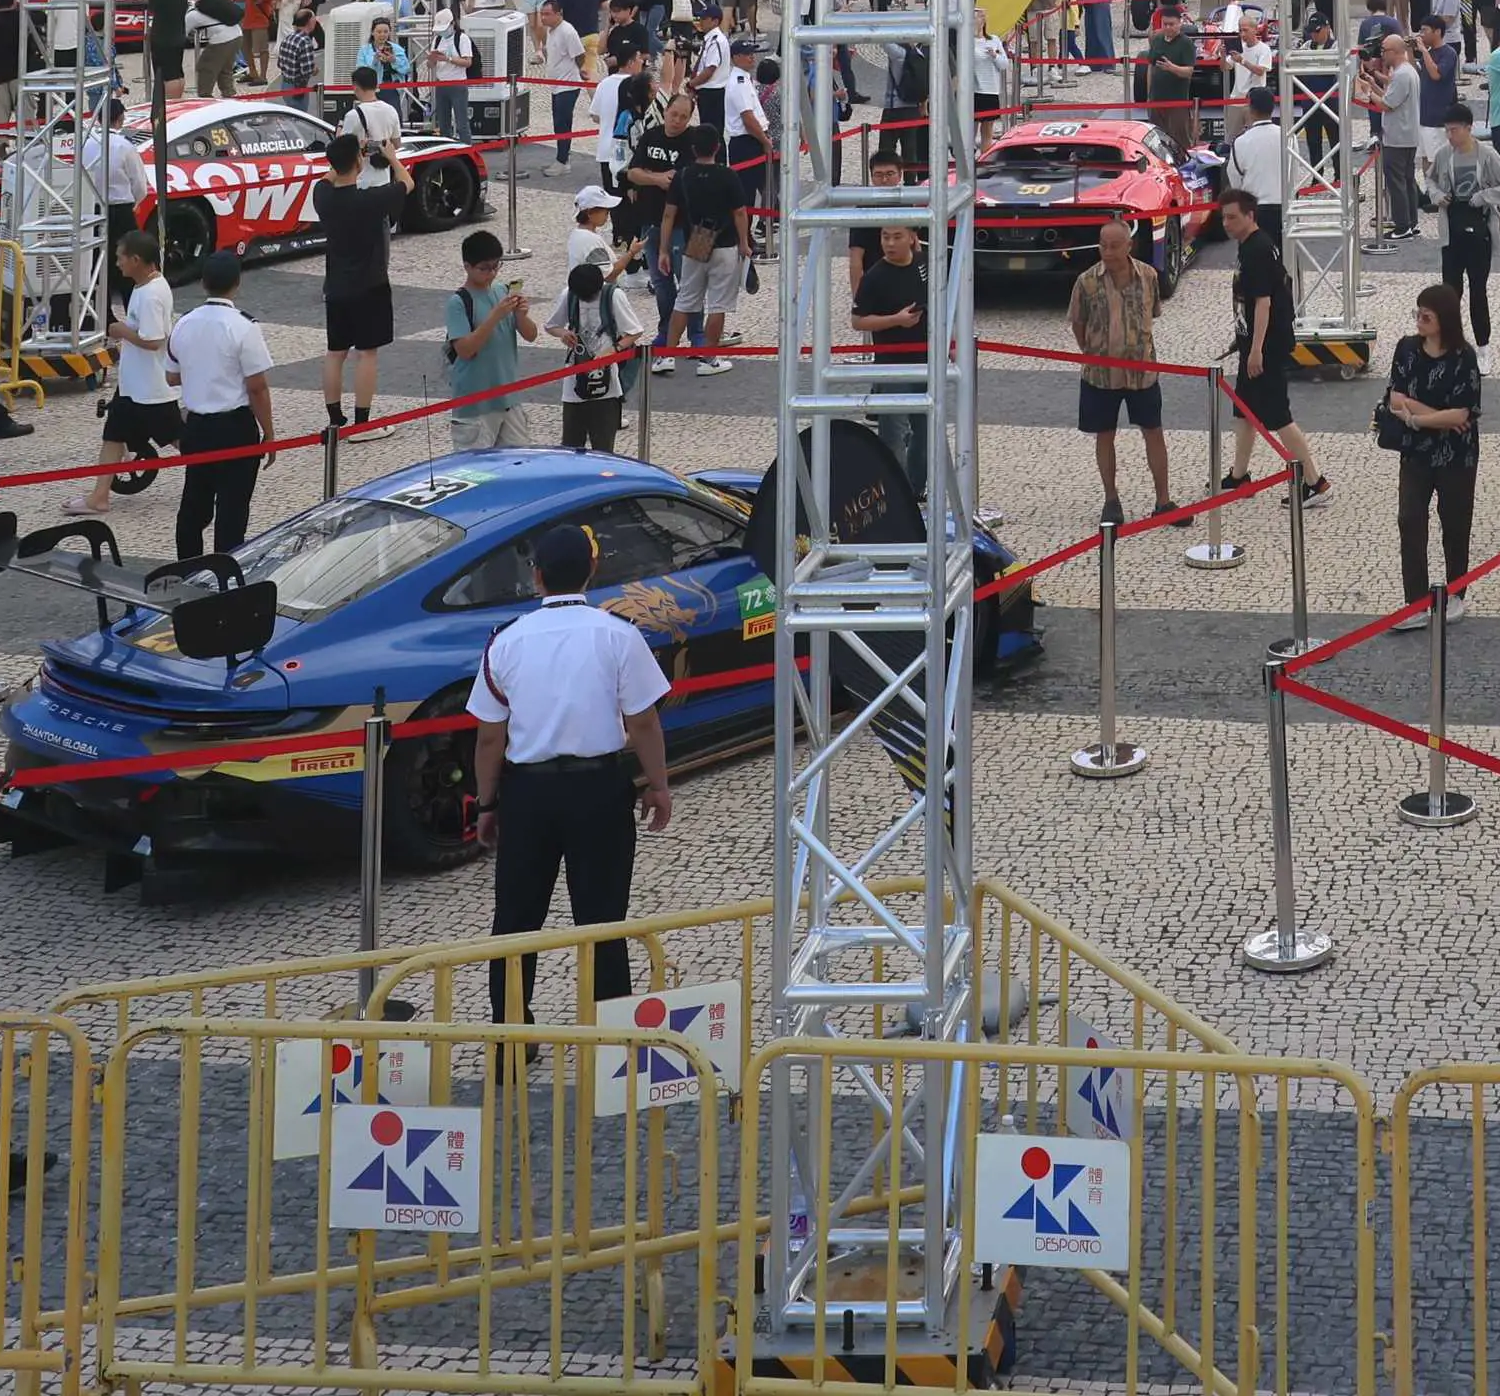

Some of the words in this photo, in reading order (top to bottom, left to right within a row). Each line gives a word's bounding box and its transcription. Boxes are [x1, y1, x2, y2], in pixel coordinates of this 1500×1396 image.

[211, 129, 229, 146] 53
[1042, 123, 1077, 136] 50
[241, 138, 305, 156] MARCIELLO
[1017, 184, 1052, 195] 50
[844, 482, 886, 521] MGM
[743, 589, 762, 611] 72
[39, 698, 127, 734] PORSCHE
[22, 723, 62, 746] PHANTOM
[62, 737, 100, 757] GLOBAL
[291, 752, 355, 772] PIRELLI
[707, 1000, 726, 1042] 體育
[446, 1129, 465, 1172] 體育
[1088, 1166, 1103, 1204] 體育
[385, 1207, 464, 1228] DESPORTO
[1034, 1238, 1102, 1255] DESPORTO
